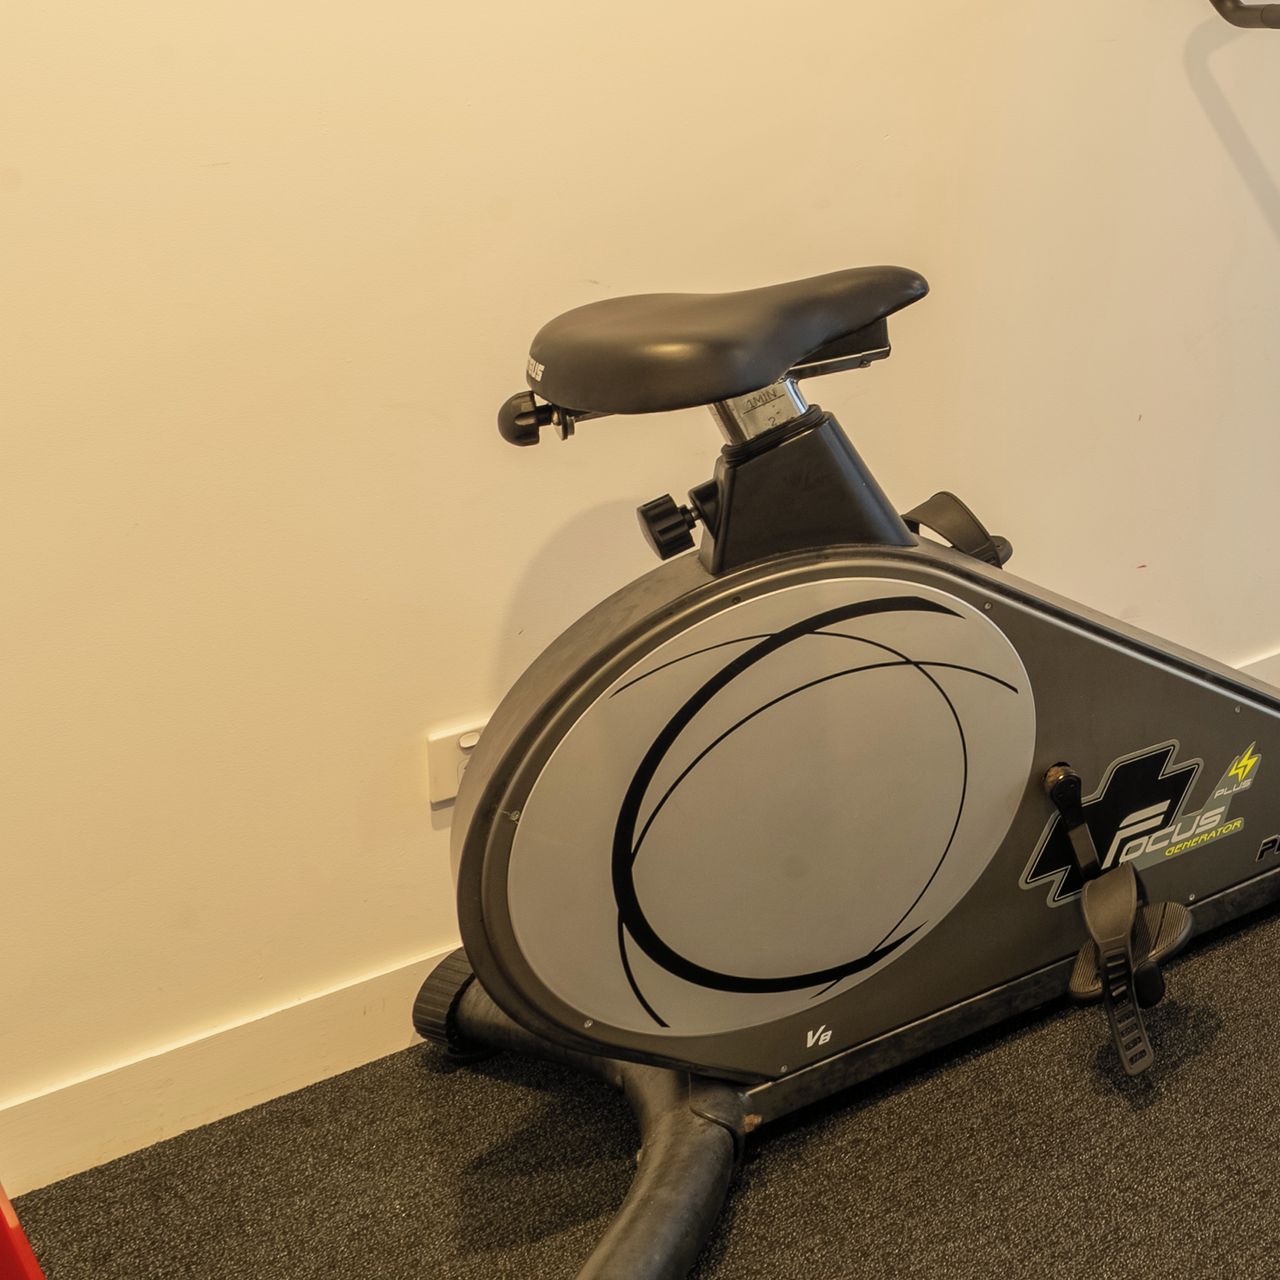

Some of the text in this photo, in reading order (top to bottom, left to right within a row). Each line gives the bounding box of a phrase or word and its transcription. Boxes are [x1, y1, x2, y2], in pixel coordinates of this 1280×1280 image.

[1214, 778, 1253, 799] PLUS
[1101, 799, 1226, 870] FOCUS
[1164, 819, 1243, 857] GENERATOR
[806, 1024, 833, 1049] V8
